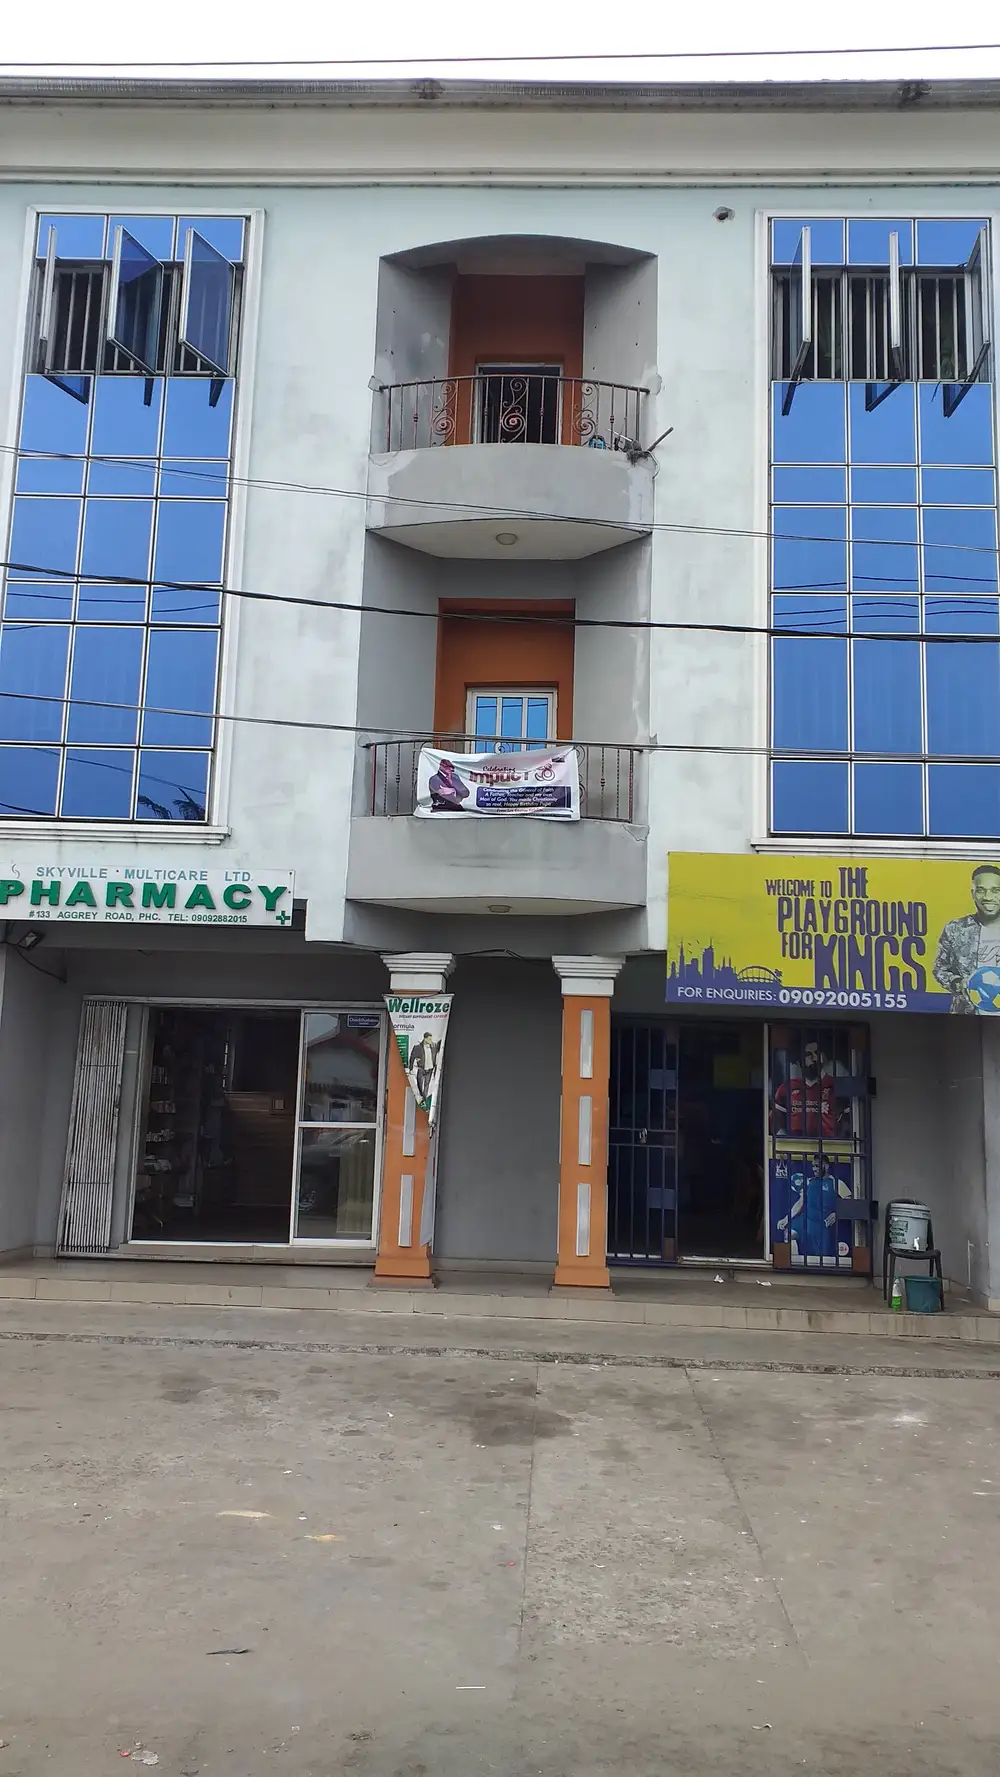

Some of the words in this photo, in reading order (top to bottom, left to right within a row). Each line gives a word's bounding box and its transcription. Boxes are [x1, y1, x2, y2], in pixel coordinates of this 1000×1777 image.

[36, 866, 108, 879] SKYVILLE
[124, 868, 209, 881] MULTICARE
[765, 879, 816, 897] WELCOME
[820, 880, 832, 898] TO
[838, 866, 869, 899] THE
[0, 879, 288, 911] PHARMACY
[29, 910, 51, 919] #133
[57, 911, 98, 920] AGGREY
[105, 912, 135, 921] ROAD,
[139, 913, 161, 921] PHC.
[168, 913, 189, 922] TEL:
[191, 914, 248, 923] 09092882015
[777, 897, 928, 937] PLAYGROUND
[781, 932, 813, 960] FOR
[814, 933, 927, 992] KINGS
[388, 998, 450, 1013] Wellroze
[677, 986, 702, 998] FOR
[706, 987, 777, 1001] ENQUIRIES:
[779, 989, 909, 1009] 09092005155
